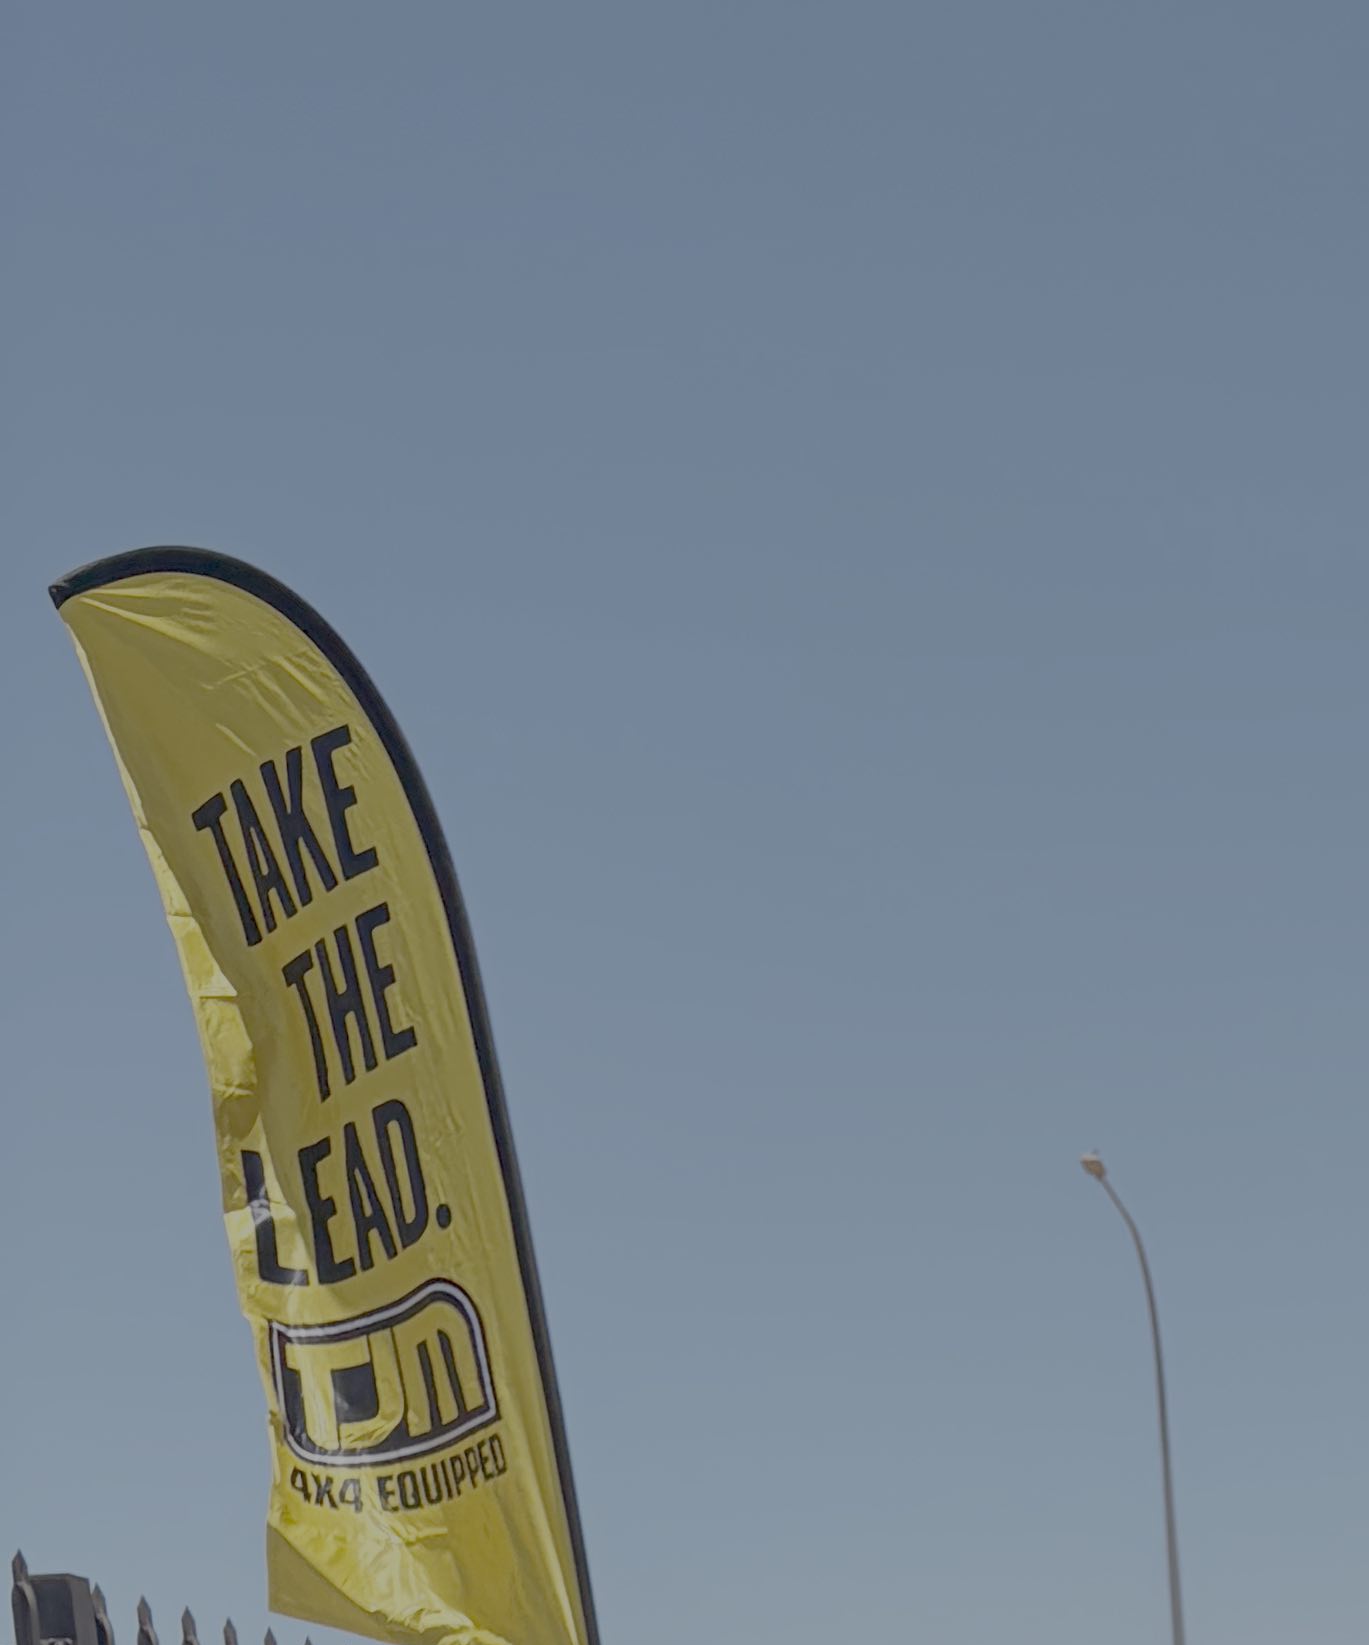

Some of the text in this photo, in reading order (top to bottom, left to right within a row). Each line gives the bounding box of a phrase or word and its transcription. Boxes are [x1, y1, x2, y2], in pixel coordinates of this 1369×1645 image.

[191, 723, 379, 947] TAKE
[281, 901, 418, 1103] THE
[241, 1098, 452, 1286] LEAD.
[285, 1305, 488, 1451] TJM
[290, 1433, 508, 1513] 4X4 EQUIPPED
